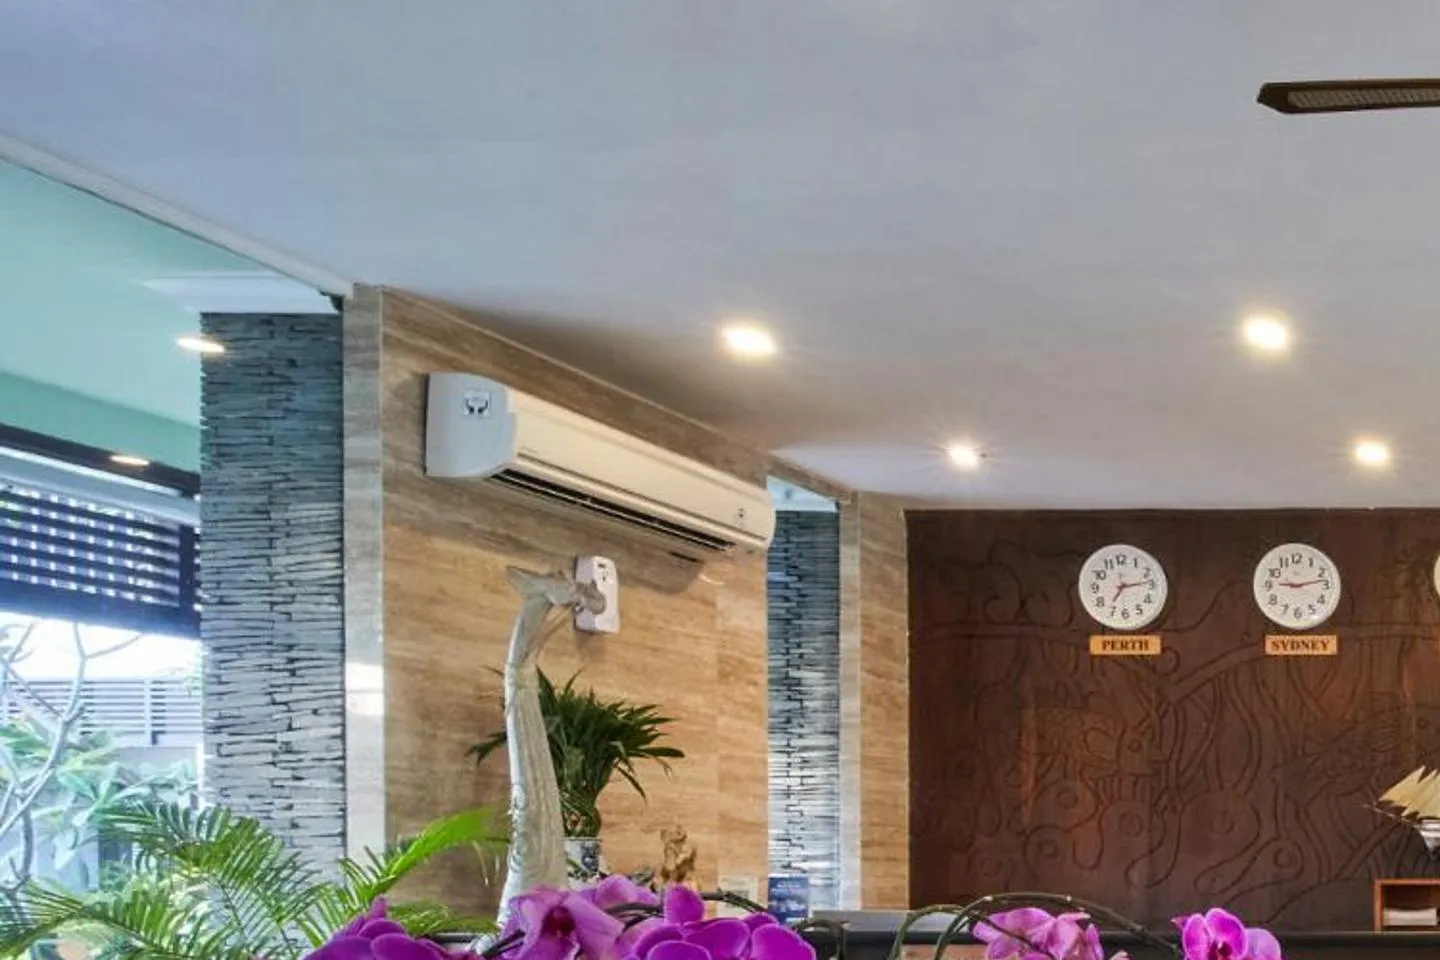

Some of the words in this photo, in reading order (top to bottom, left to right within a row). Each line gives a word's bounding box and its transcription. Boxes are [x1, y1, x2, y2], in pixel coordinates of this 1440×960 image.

[1116, 555, 1126, 565] 12
[1280, 558, 1289, 568] 11
[1291, 553, 1302, 564] 12
[1104, 559, 1114, 570] 11
[1144, 567, 1151, 578] 2
[1318, 568, 1325, 577] 2
[1091, 583, 1099, 593] 9
[1265, 581, 1273, 591] 9
[1096, 596, 1104, 607] 8
[1144, 594, 1152, 604] 4
[1269, 594, 1277, 605] 8
[1317, 594, 1325, 604] 4
[1111, 606, 1117, 616] 7
[1121, 608, 1129, 619] 6
[1135, 604, 1143, 615] 5
[1281, 605, 1289, 614] 7
[1294, 607, 1302, 618] 6
[1308, 604, 1316, 614] 5
[1102, 640, 1149, 650] PERTH
[1271, 640, 1330, 651] SYDNEY
